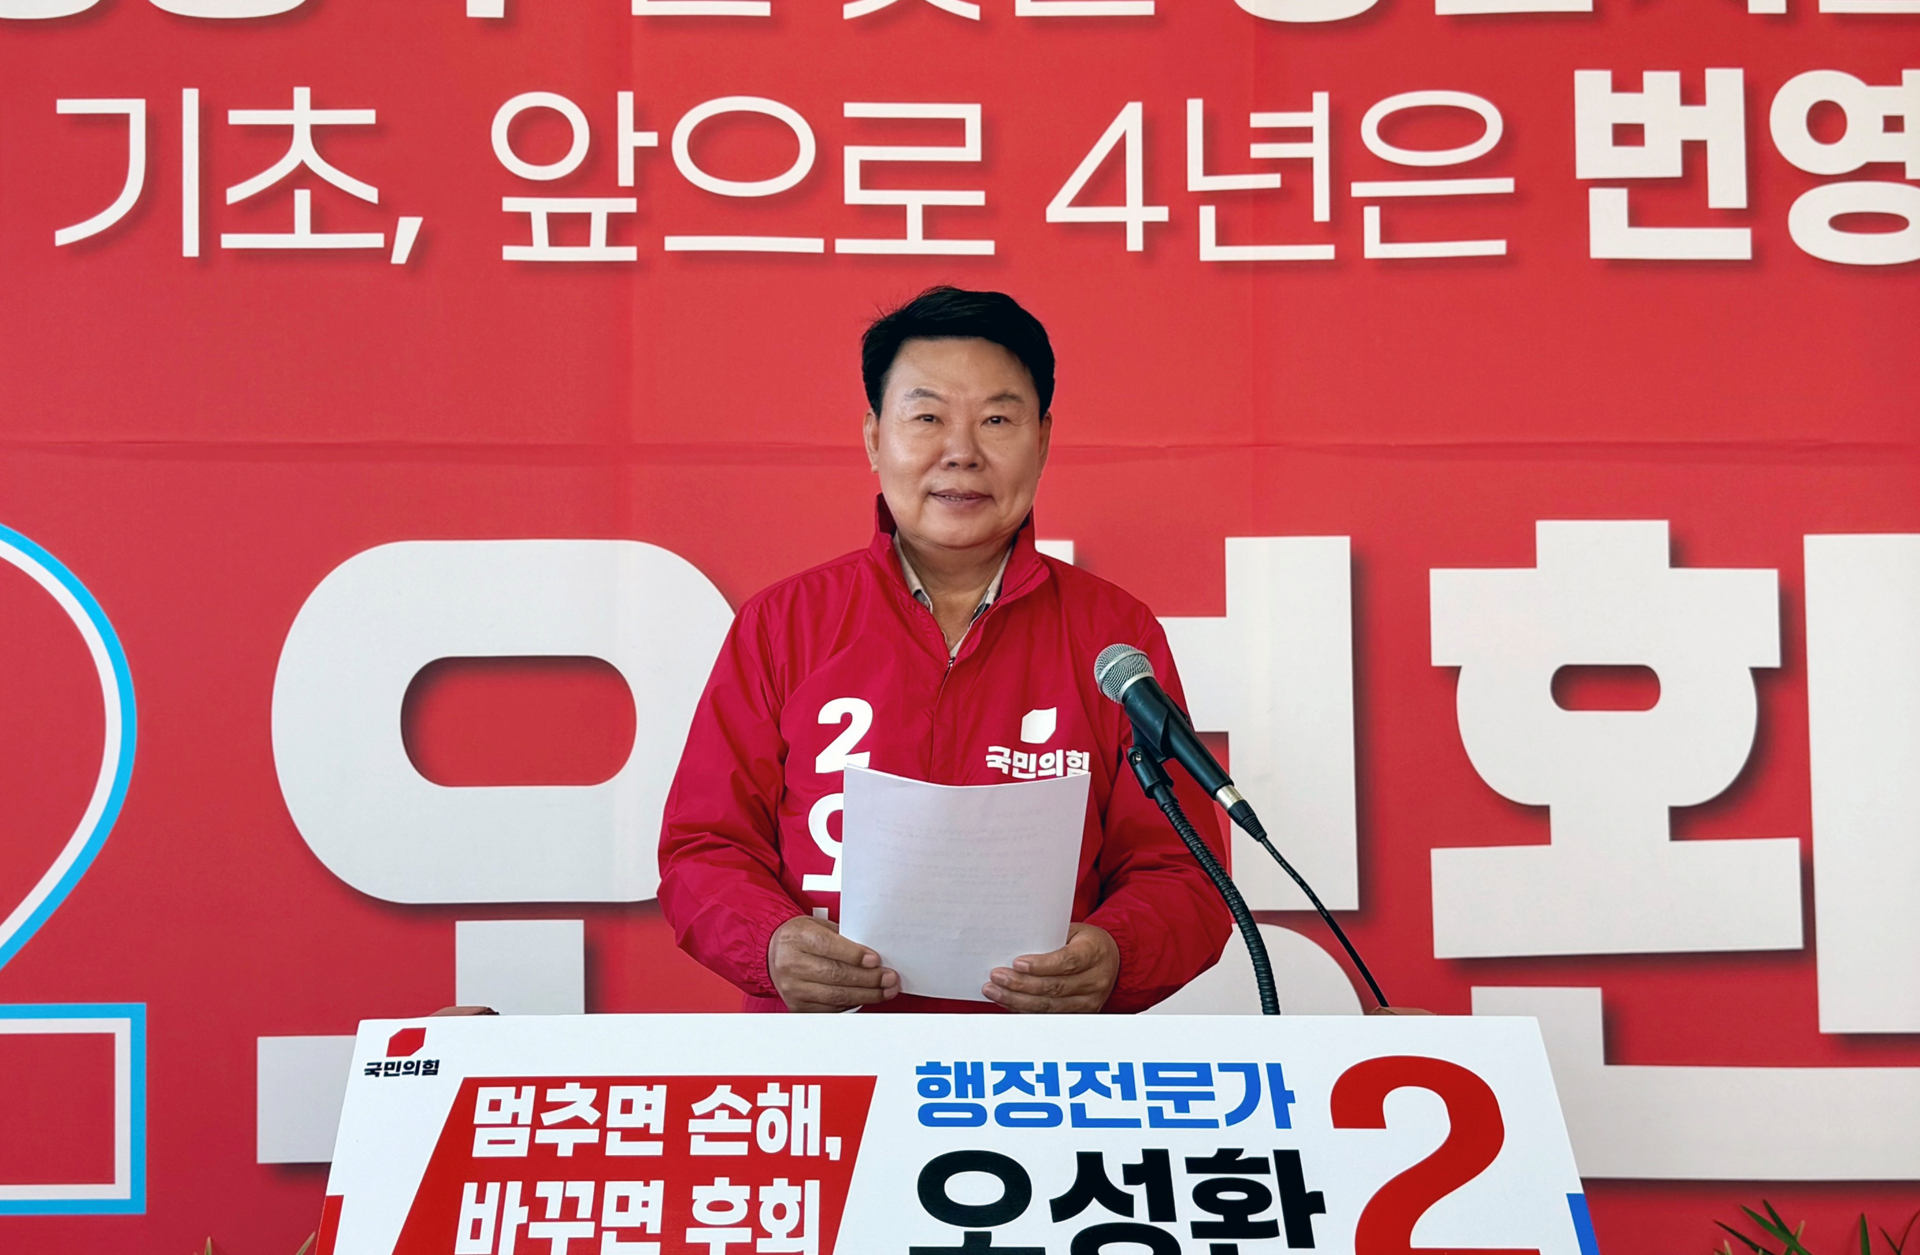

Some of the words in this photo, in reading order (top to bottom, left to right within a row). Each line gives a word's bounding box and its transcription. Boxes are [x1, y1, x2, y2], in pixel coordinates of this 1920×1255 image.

[55, 87, 424, 264] 기초,
[490, 91, 995, 262] 앞으로
[1045, 89, 1515, 262] 4년은
[1573, 67, 1920, 266] 번영
[815, 697, 873, 774] 2
[985, 745, 1090, 779] 국민의힘
[364, 1059, 440, 1078] 국민의힘
[915, 1060, 1296, 1129] 행정전문가
[472, 1082, 668, 1158] 멈추면
[687, 1082, 842, 1161] 손해,
[1330, 1055, 1543, 1255] 2
[454, 1179, 665, 1255] 바꾸면
[685, 1176, 820, 1255] 후회
[908, 1147, 1327, 1255] 오성환
